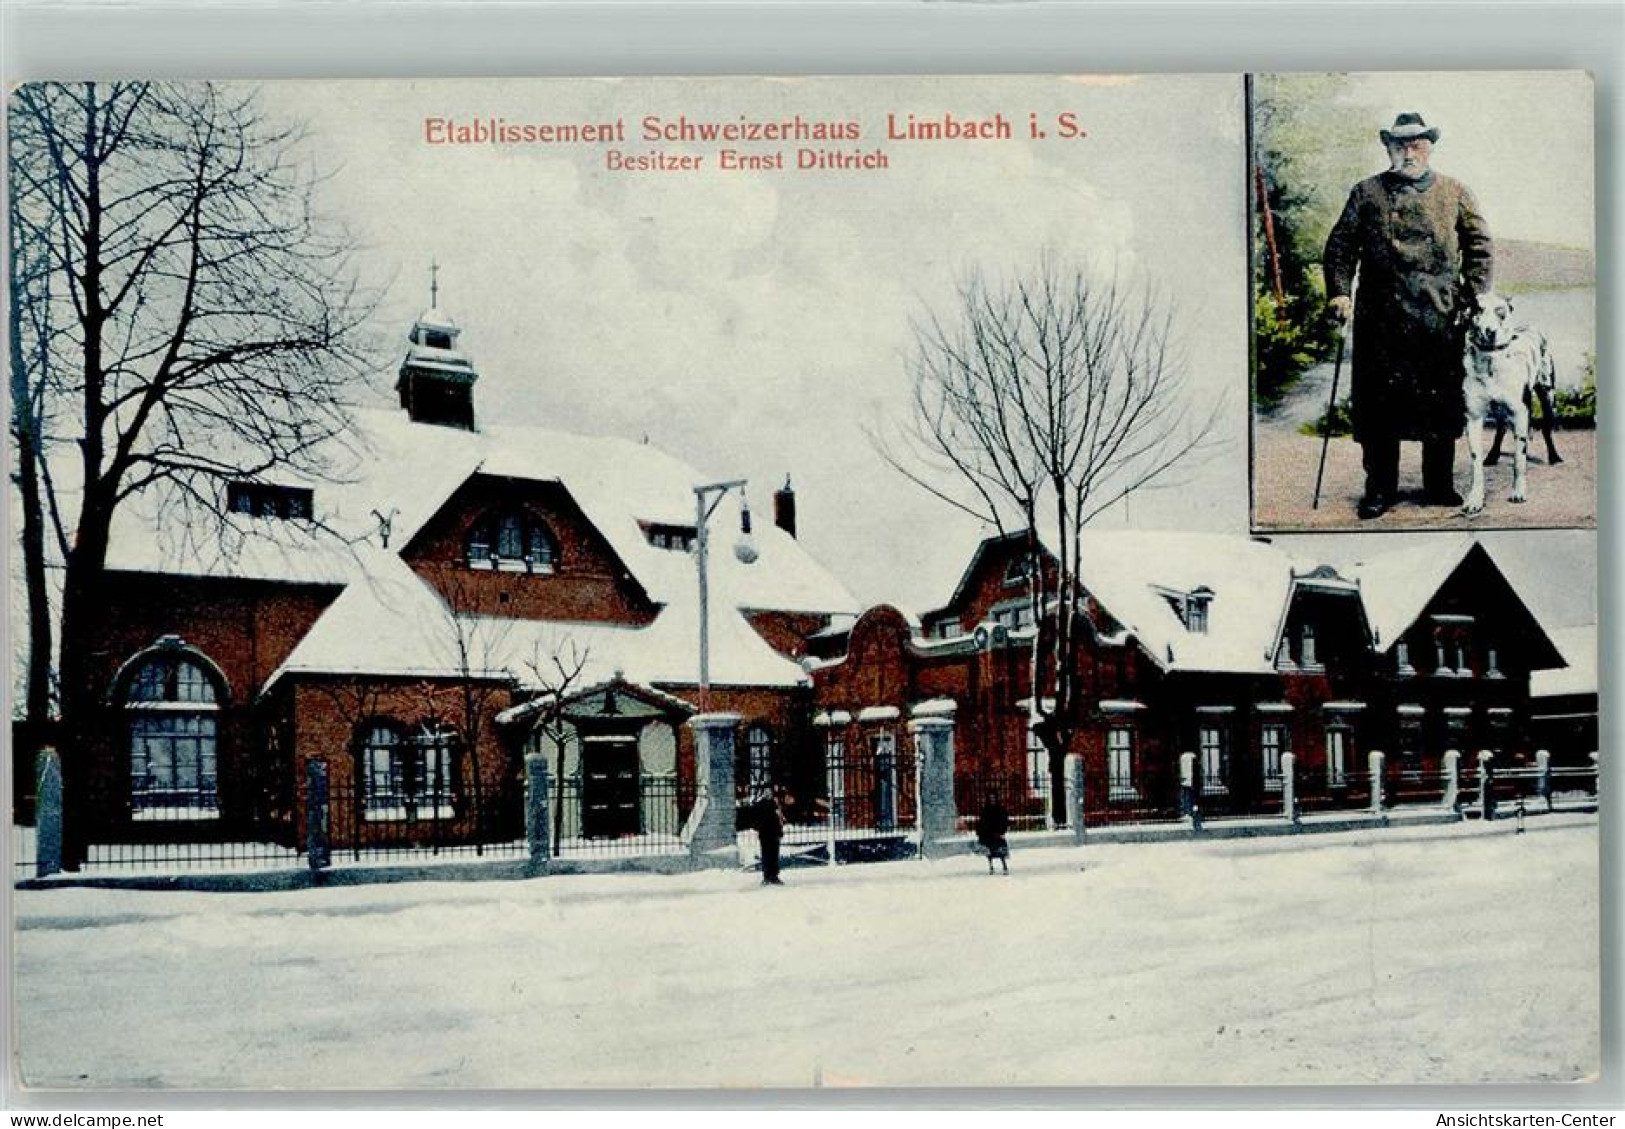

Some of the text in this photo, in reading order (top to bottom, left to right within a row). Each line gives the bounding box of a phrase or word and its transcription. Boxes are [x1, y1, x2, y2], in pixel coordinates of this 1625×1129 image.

[425, 111, 1088, 143] Etablissement Schweizerhaus Limbach i. S.
[606, 149, 890, 171] Besitzer Ernst Dittrich
